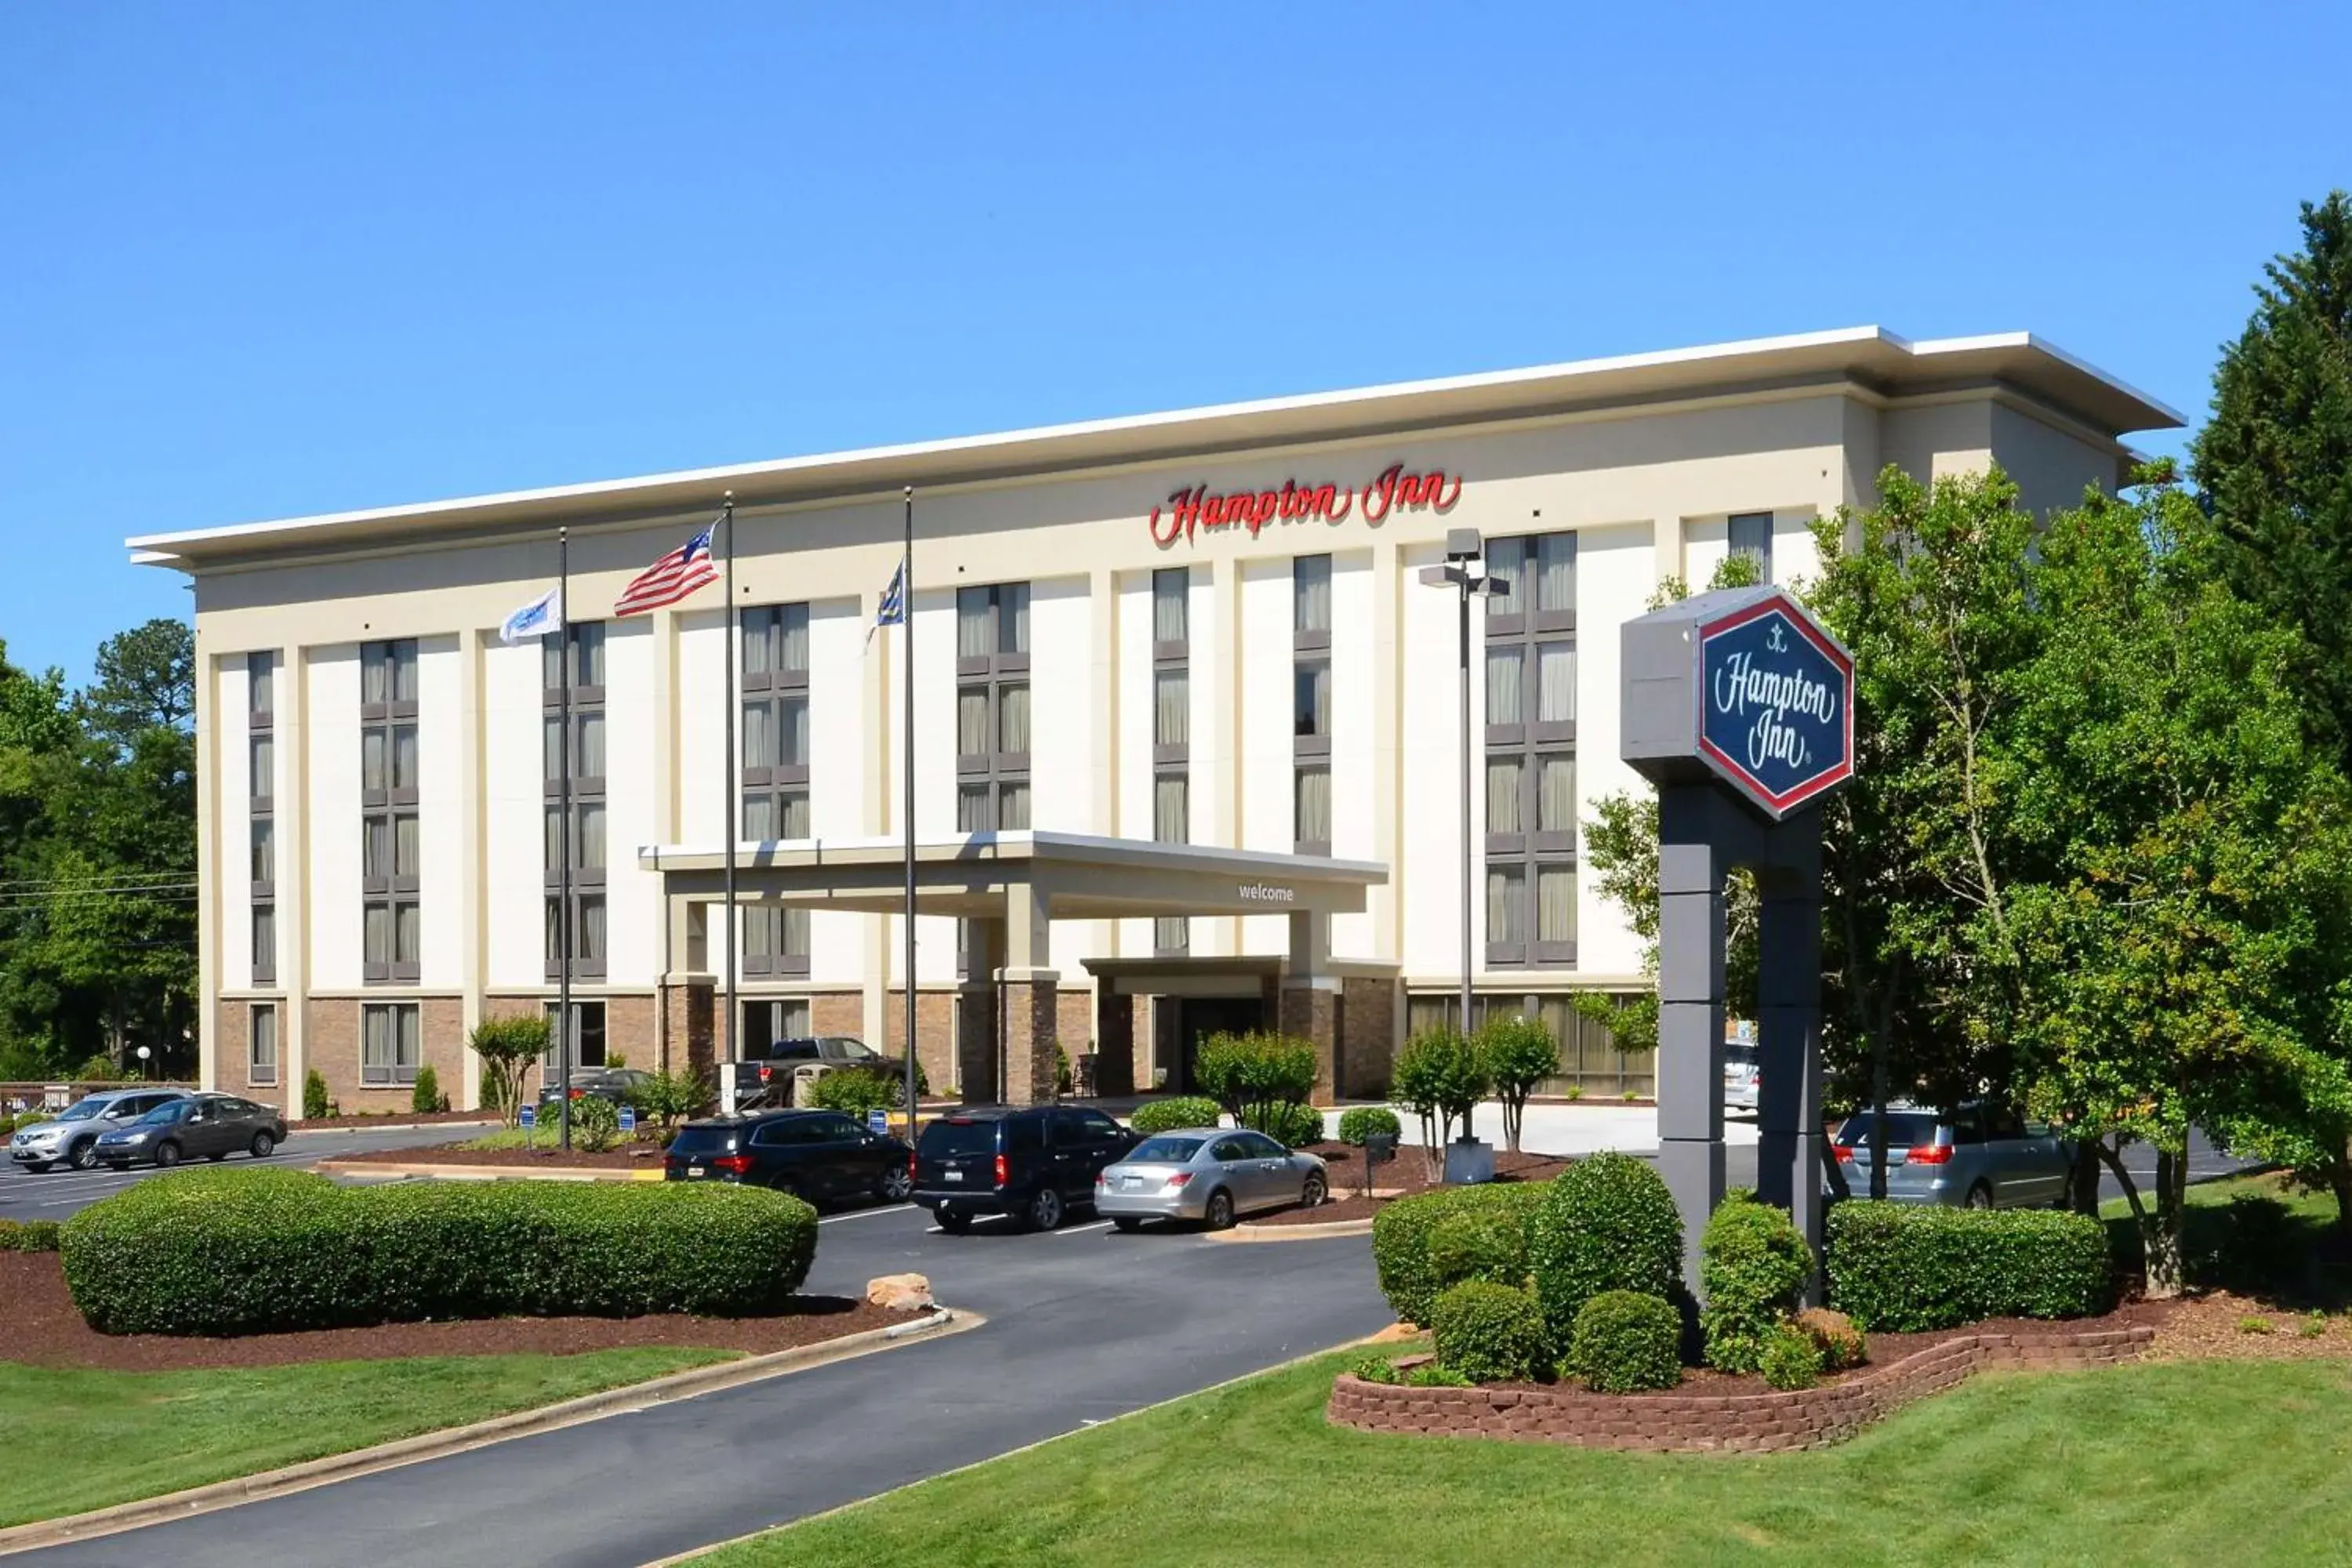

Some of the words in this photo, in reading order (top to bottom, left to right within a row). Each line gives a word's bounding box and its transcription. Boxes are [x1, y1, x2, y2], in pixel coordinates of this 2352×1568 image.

[1150, 478, 1352, 546] Hampton
[1360, 464, 1461, 522] Inn
[1715, 652, 1835, 724] Hampton
[1748, 709, 1804, 770] Inn
[1239, 882, 1294, 902] welcome
